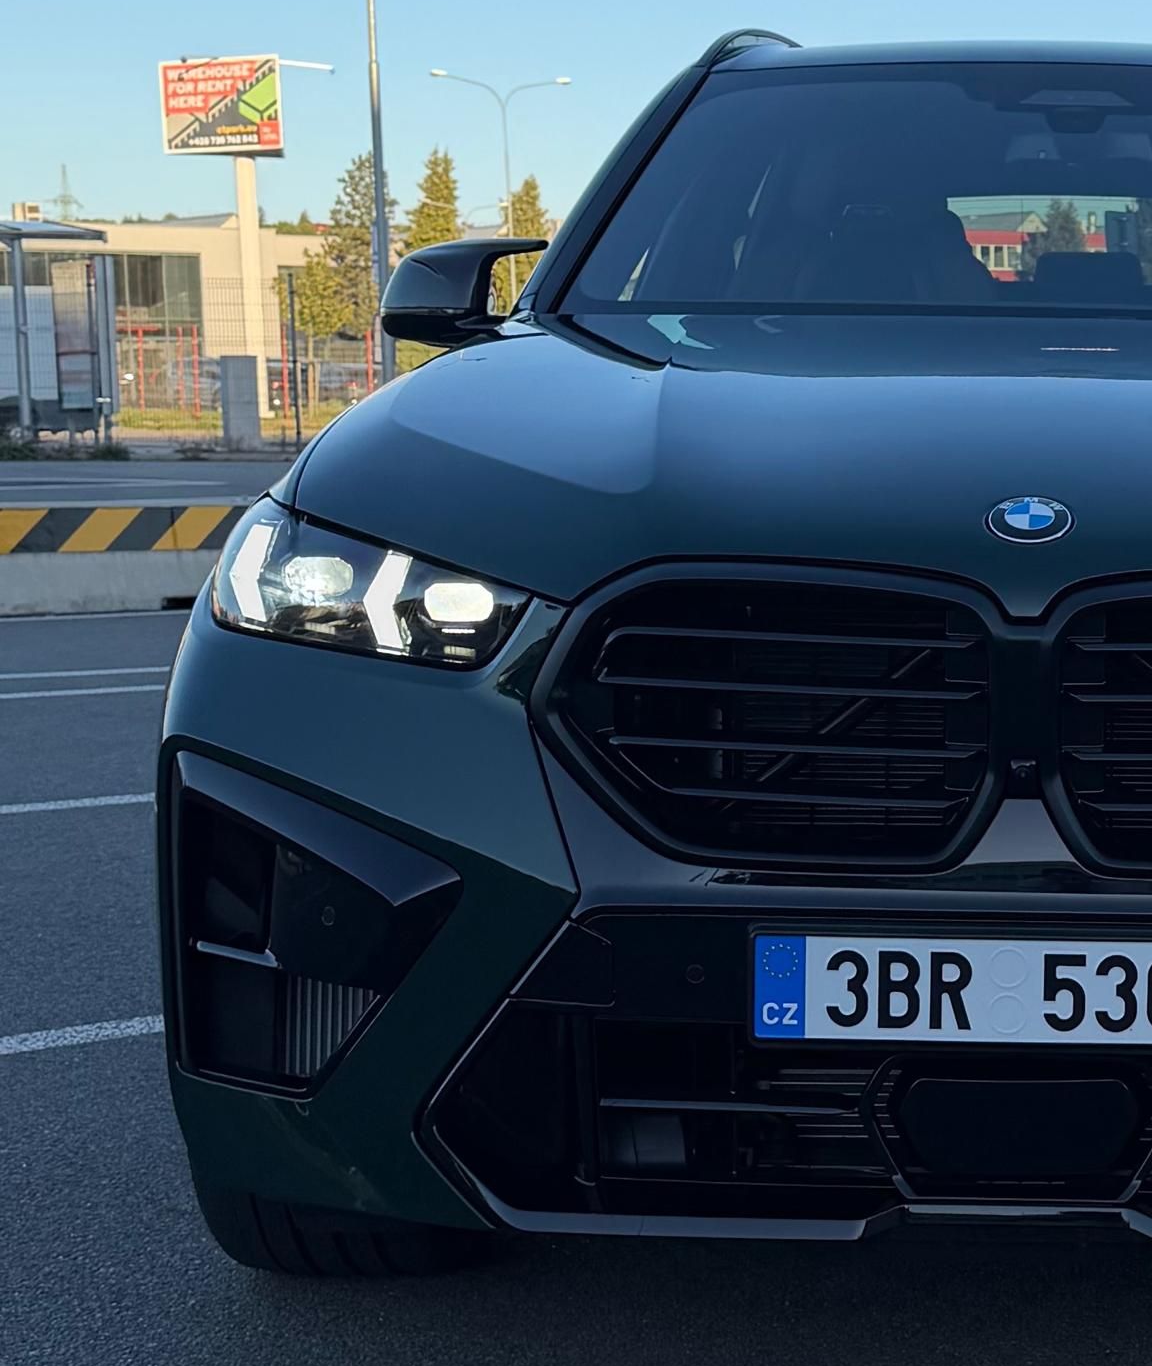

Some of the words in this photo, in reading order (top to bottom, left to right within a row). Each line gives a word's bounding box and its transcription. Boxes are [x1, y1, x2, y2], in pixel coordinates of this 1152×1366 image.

[167, 65, 250, 80] WAREHOUSE
[168, 82, 195, 94] FOR
[197, 80, 232, 93] RENT
[168, 96, 204, 108] HERE
[998, 497, 1063, 510] BMW
[825, 948, 974, 1031] 3BR
[761, 1001, 799, 1026] CZ
